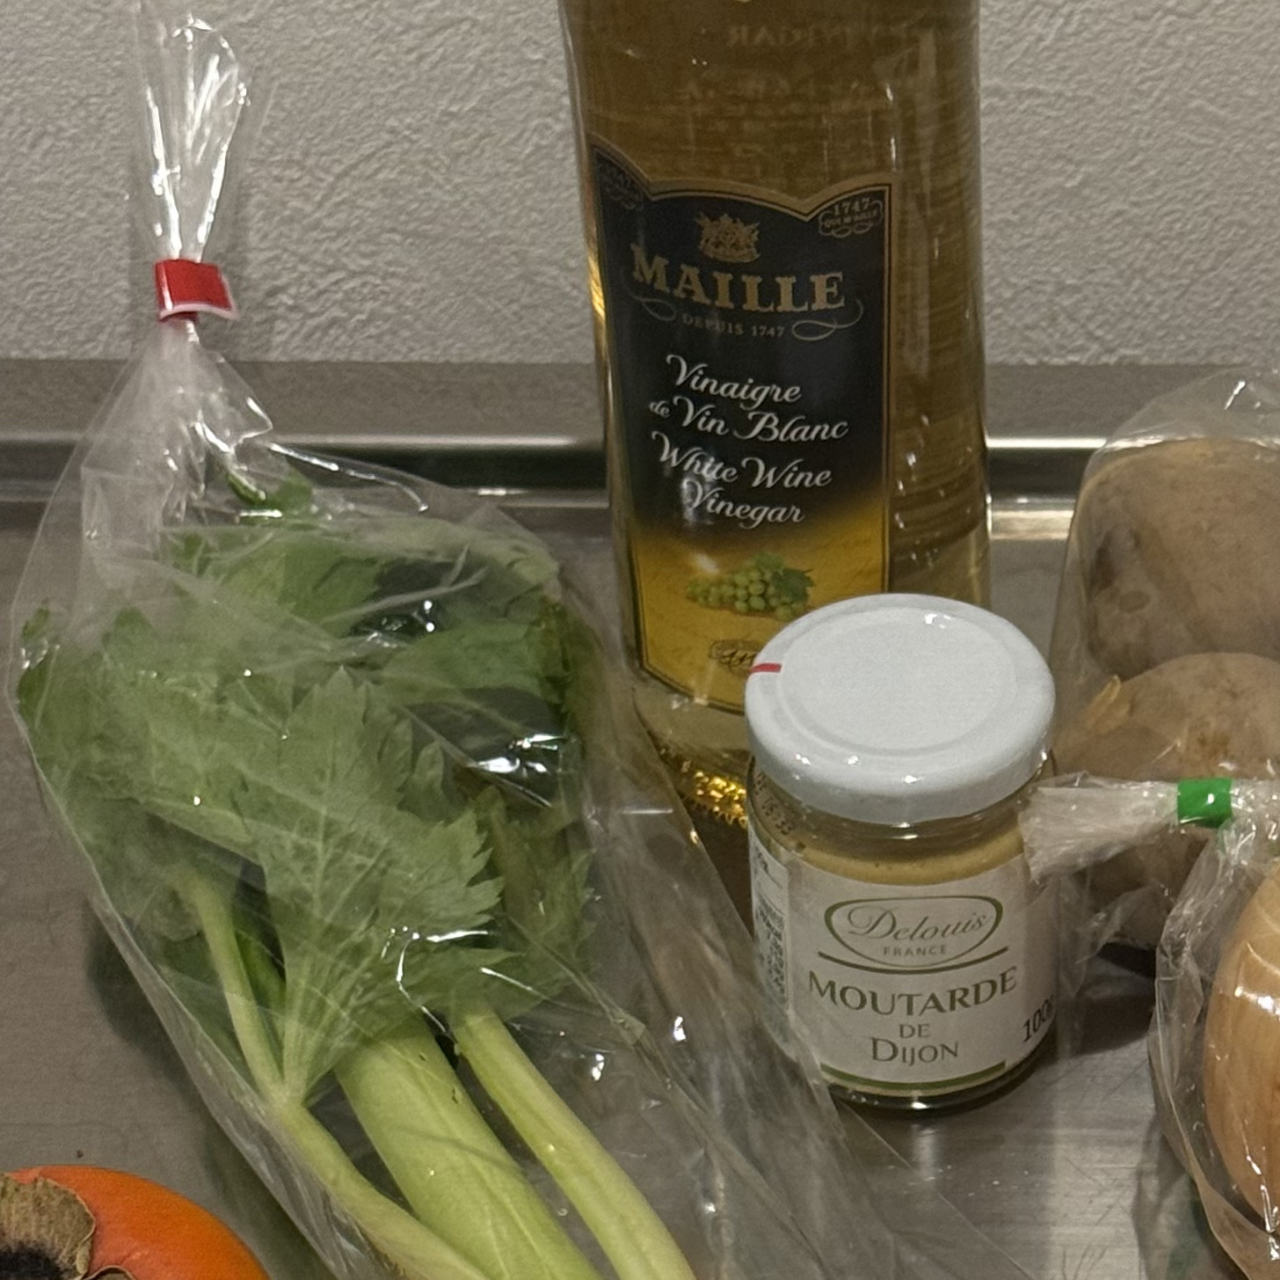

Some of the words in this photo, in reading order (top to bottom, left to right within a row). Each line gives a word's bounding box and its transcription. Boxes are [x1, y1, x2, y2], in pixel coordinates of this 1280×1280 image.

[630, 242, 845, 313] MAILLE
[682, 313, 744, 336] DEPUIS
[751, 325, 785, 338] 1747
[665, 354, 802, 411] Vinaigre
[649, 400, 671, 418] de
[673, 396, 729, 436] Vin
[733, 410, 849, 443] Blanc
[651, 431, 739, 484] White
[741, 457, 833, 489] Wine
[682, 478, 805, 529] Vinegar
[847, 904, 990, 942] Delouis
[883, 945, 947, 957] FRANCE
[808, 966, 1018, 1017] MOUTARDE
[870, 1037, 960, 1068] DIJON
[899, 1023, 931, 1039] DE
